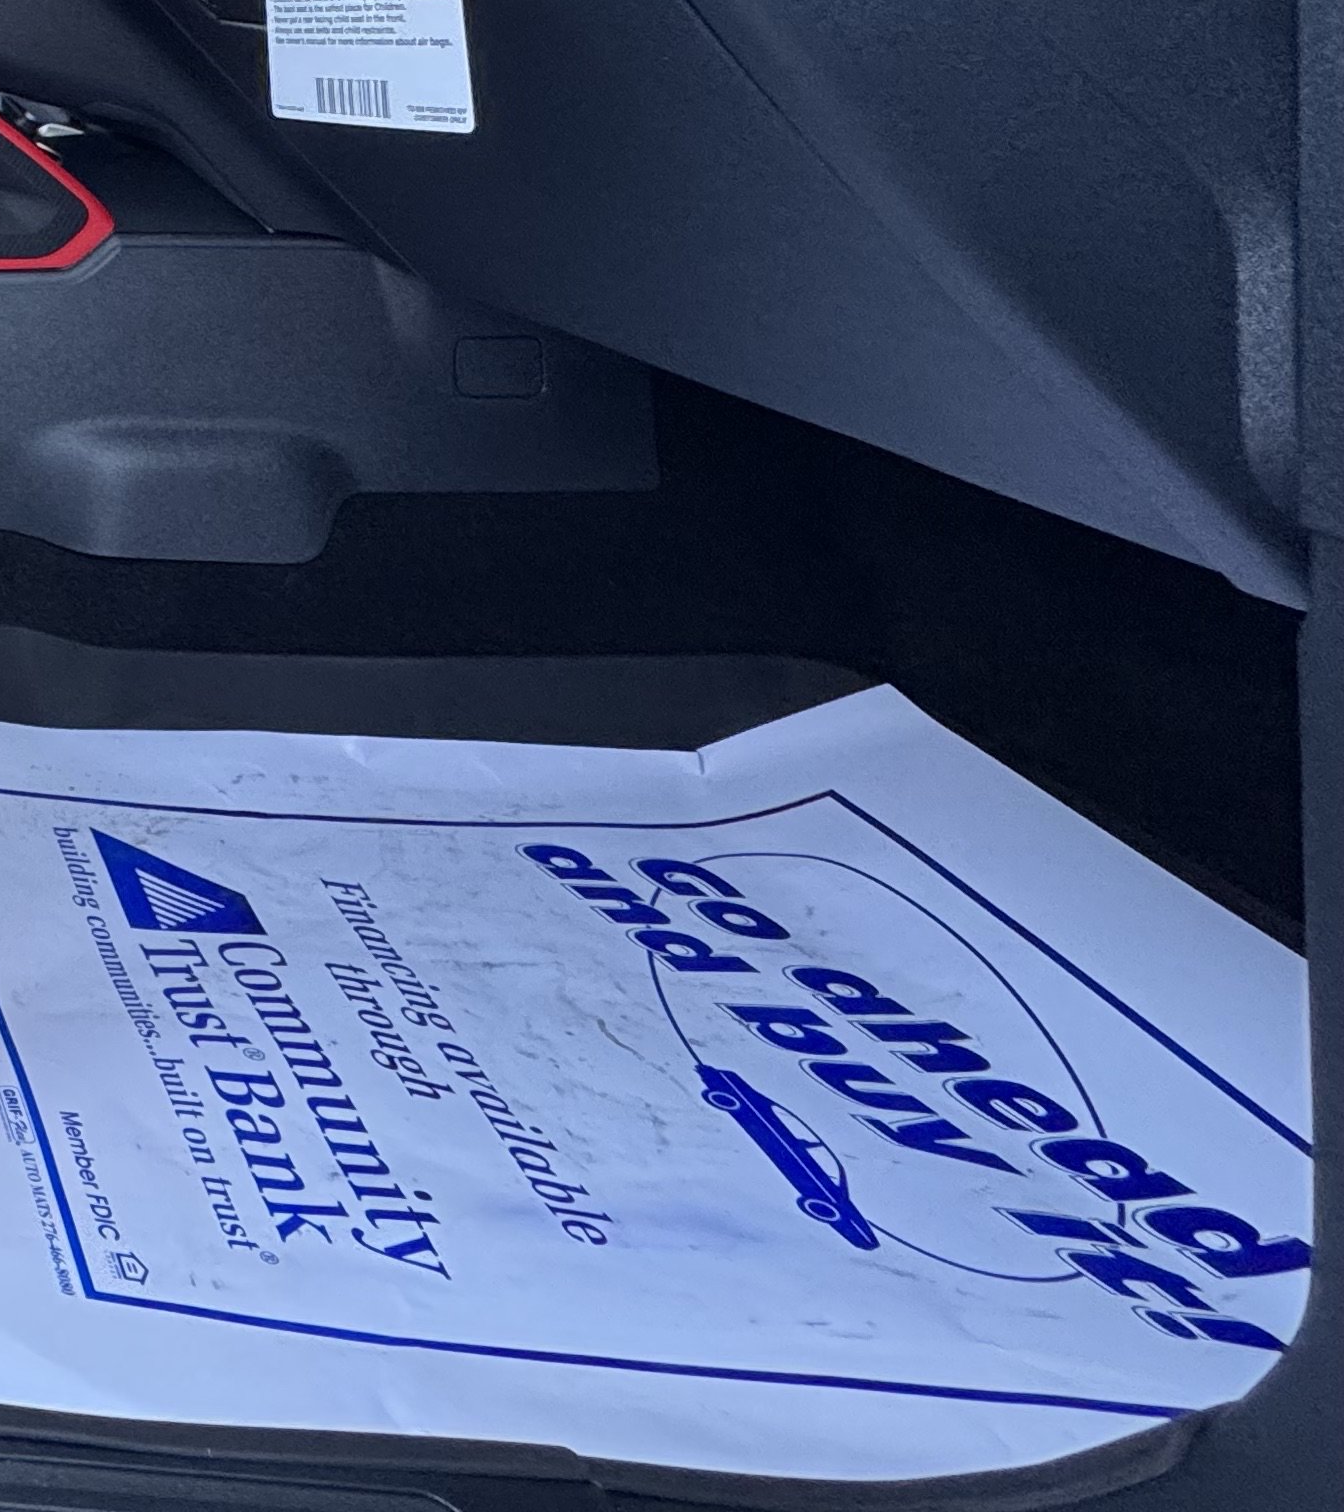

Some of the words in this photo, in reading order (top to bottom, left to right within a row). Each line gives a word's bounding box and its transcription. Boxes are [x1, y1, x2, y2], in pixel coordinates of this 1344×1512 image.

[53, 826, 101, 911] building
[182, 1127, 216, 1164] on
[218, 942, 452, 1280] Community
[320, 877, 457, 1034] Financing
[437, 1042, 614, 1246] available
[325, 962, 456, 1100] through
[514, 841, 761, 974] and
[713, 1001, 1036, 1177] buy
[630, 856, 791, 941] Go
[781, 963, 1311, 1280] ahead
[21, 1148, 42, 1183] AUTO
[31, 1183, 53, 1220] MATS
[59, 1110, 99, 1190] Member
[86, 1193, 121, 1242] FDIC
[204, 1065, 350, 1244] Bank
